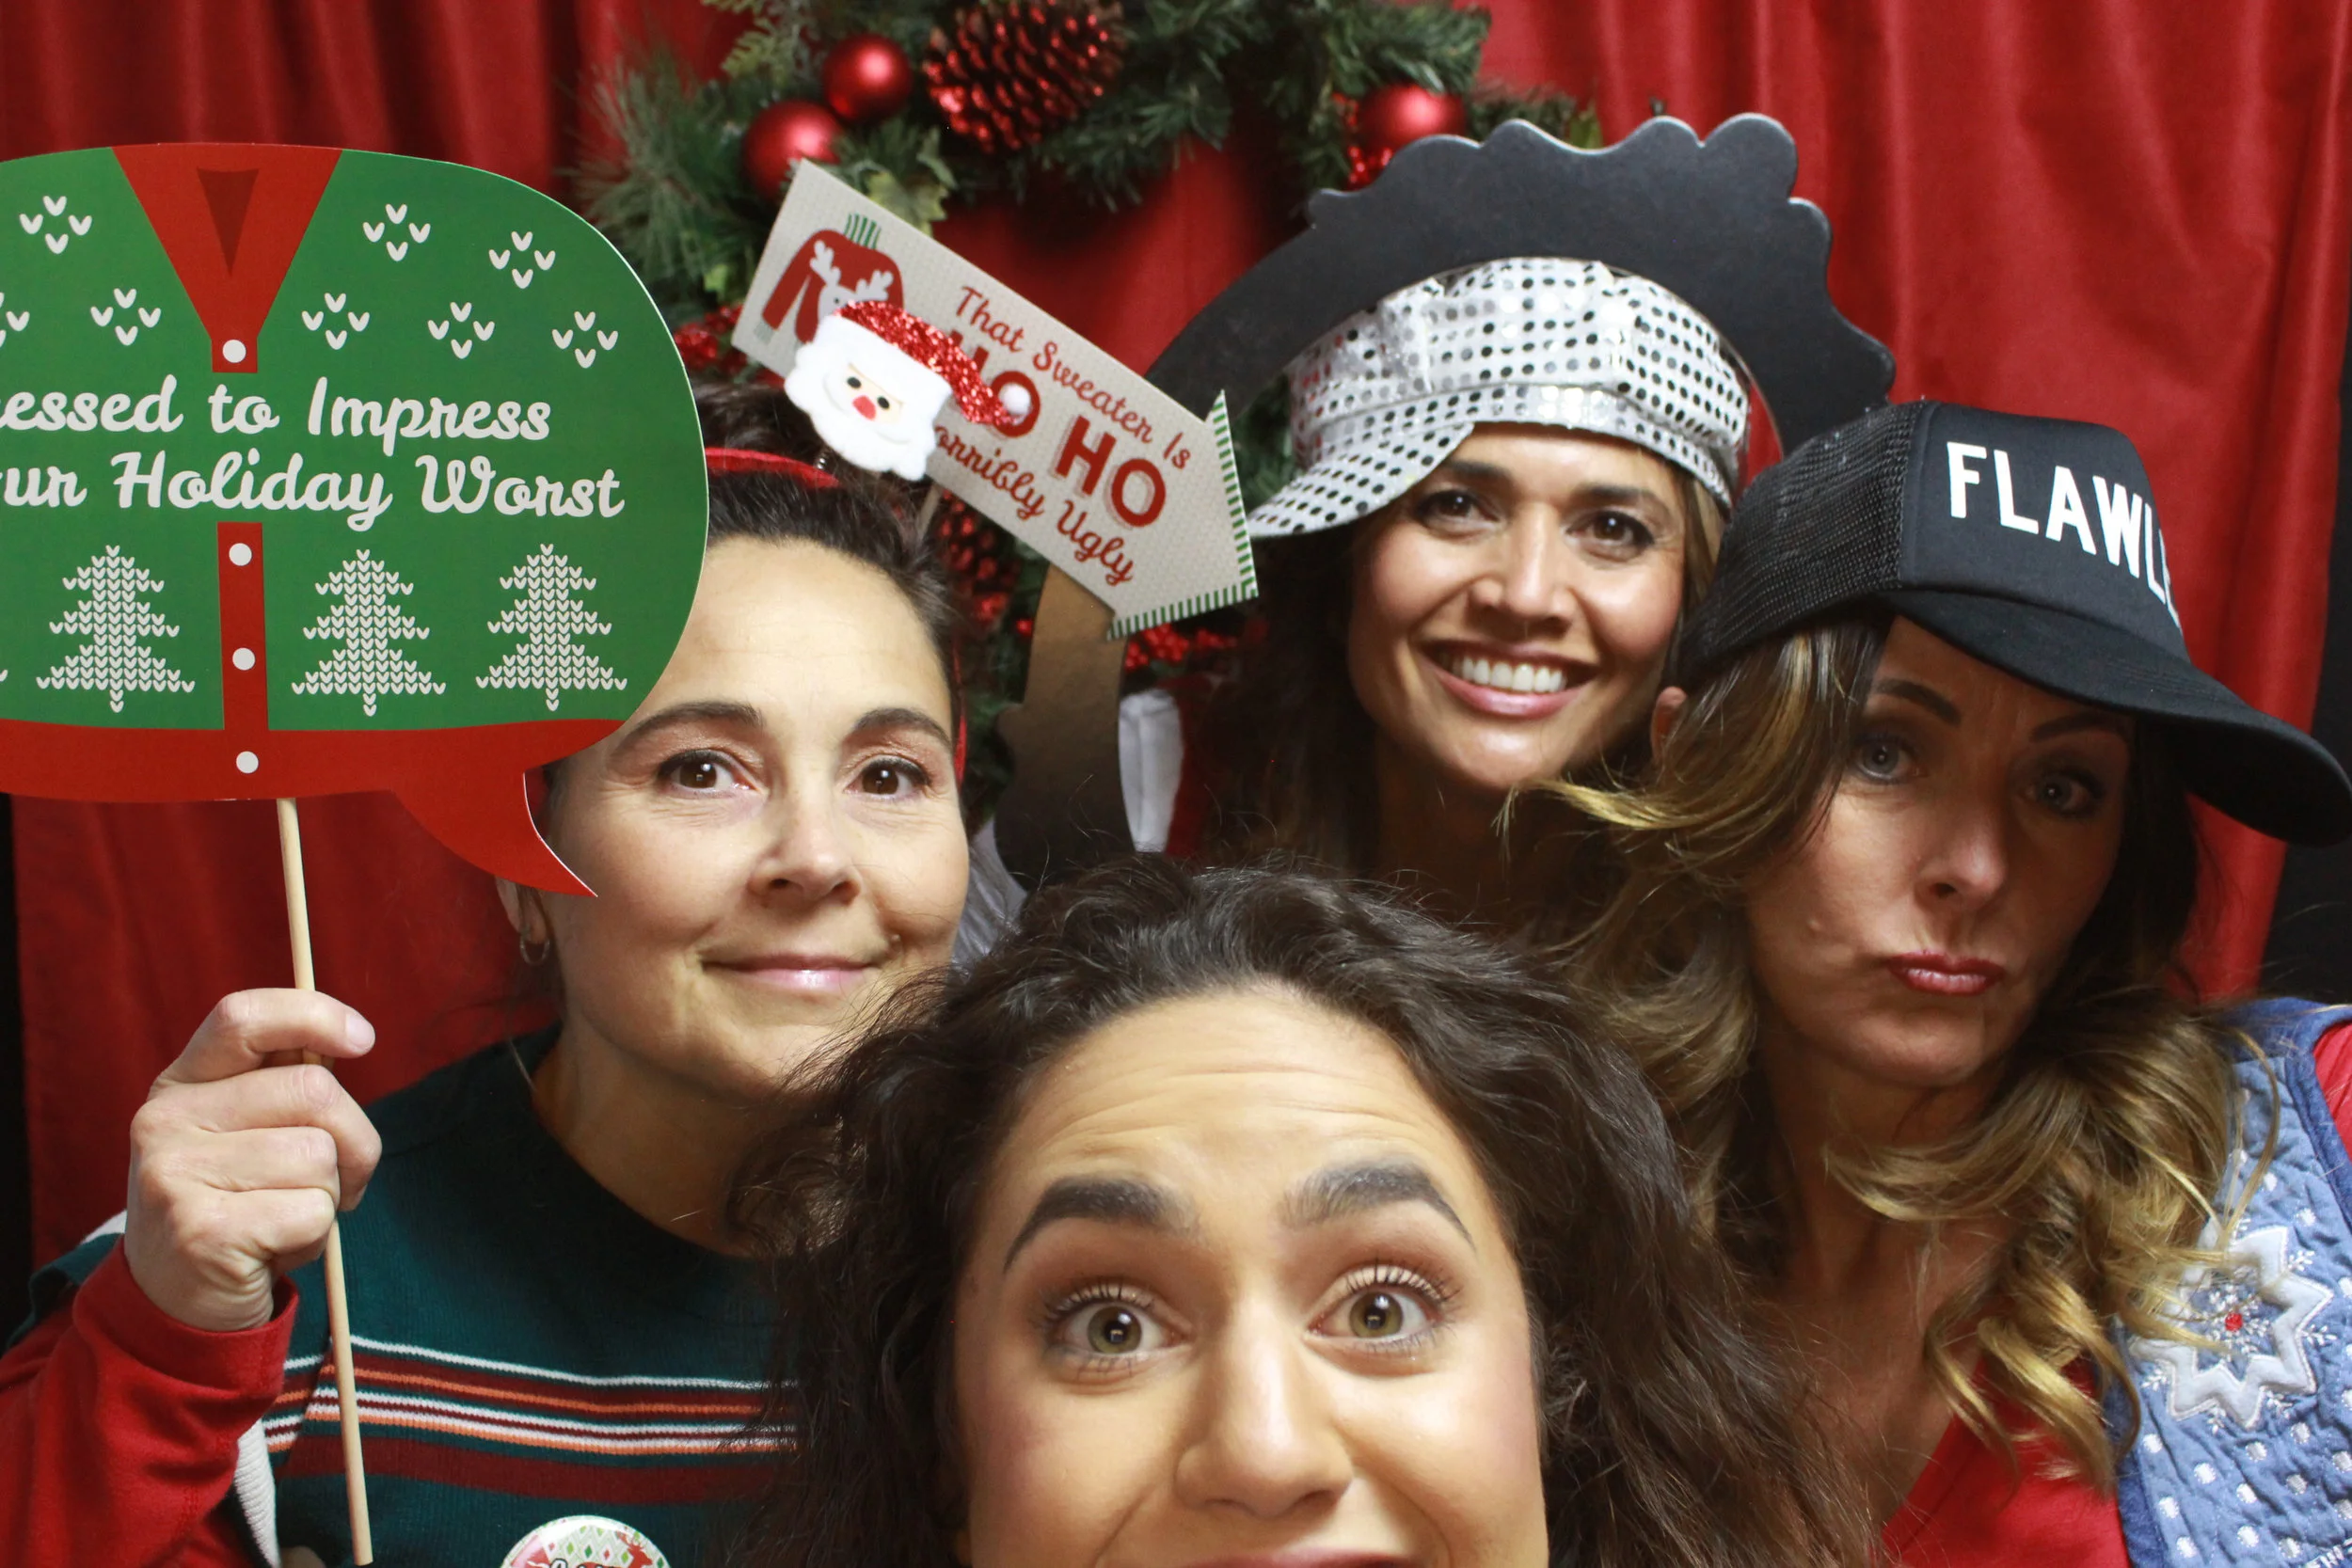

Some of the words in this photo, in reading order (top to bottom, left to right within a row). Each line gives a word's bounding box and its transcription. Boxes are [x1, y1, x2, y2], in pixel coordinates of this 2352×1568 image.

[0, 374, 183, 432] essed
[209, 385, 279, 434] to
[308, 377, 550, 456] Impress
[955, 284, 1025, 354] That
[1032, 340, 1154, 445] Sweater
[1163, 430, 1192, 471] Is
[948, 329, 1041, 439] O
[1053, 414, 1167, 529] HO
[0, 467, 87, 507] ur
[111, 448, 394, 531] Holiday
[416, 455, 625, 517] Worst
[1057, 499, 1135, 587] Ugly
